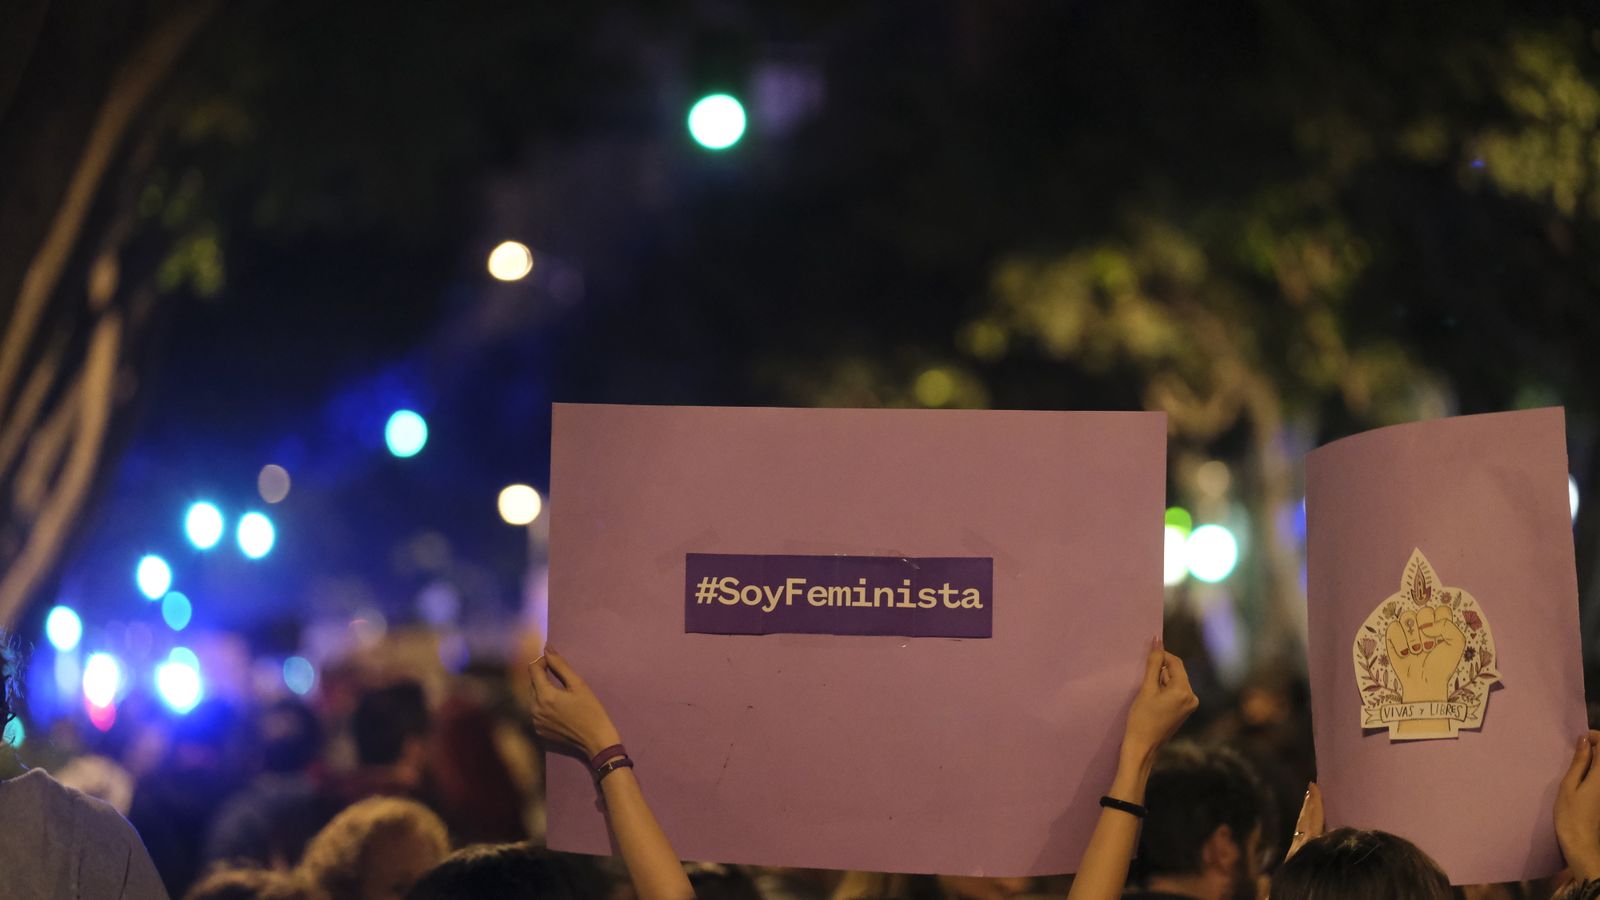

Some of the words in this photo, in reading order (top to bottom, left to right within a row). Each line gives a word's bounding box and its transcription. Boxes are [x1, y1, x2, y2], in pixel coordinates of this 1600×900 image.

[695, 576, 984, 612] #SoyFeminista
[1384, 705, 1414, 718] VIVAS
[1430, 703, 1464, 718] LIBRES
